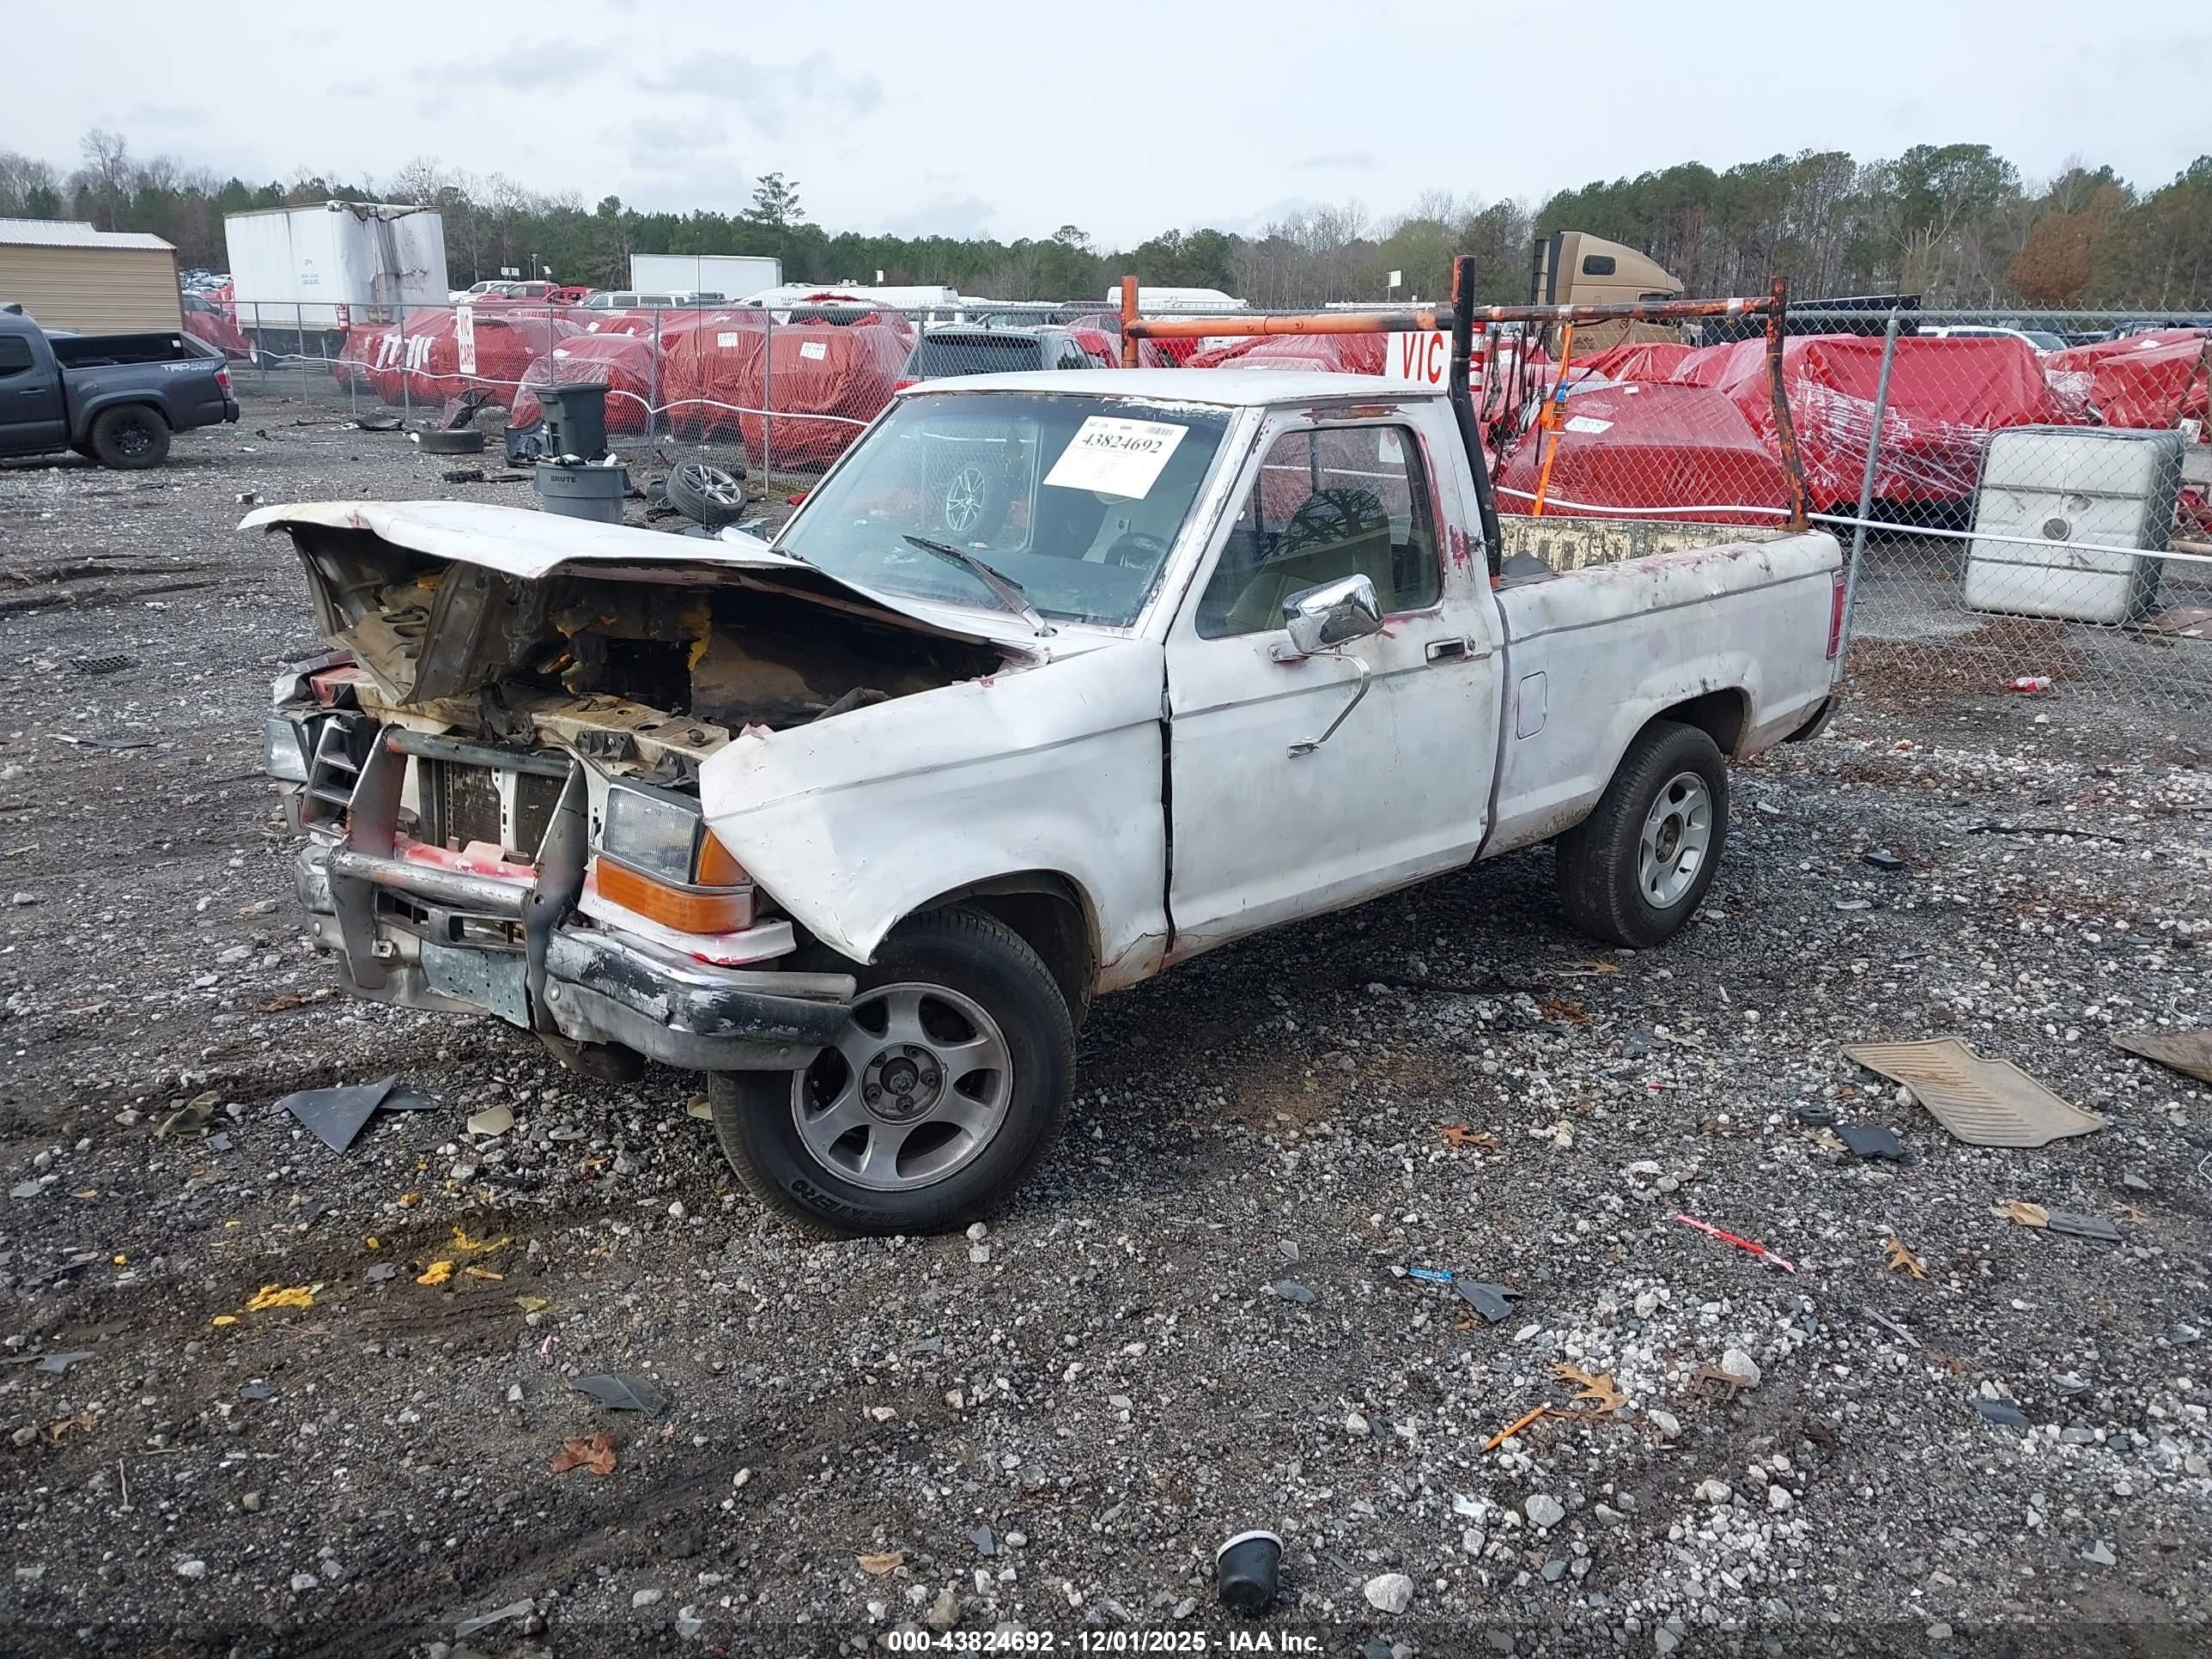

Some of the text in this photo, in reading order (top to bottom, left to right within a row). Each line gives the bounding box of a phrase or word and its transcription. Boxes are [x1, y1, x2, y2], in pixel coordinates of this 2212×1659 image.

[459, 313, 471, 337] VIC
[460, 343, 474, 366] CARS
[1402, 332, 1443, 385] VIC
[1082, 432, 1163, 453] 43824692
